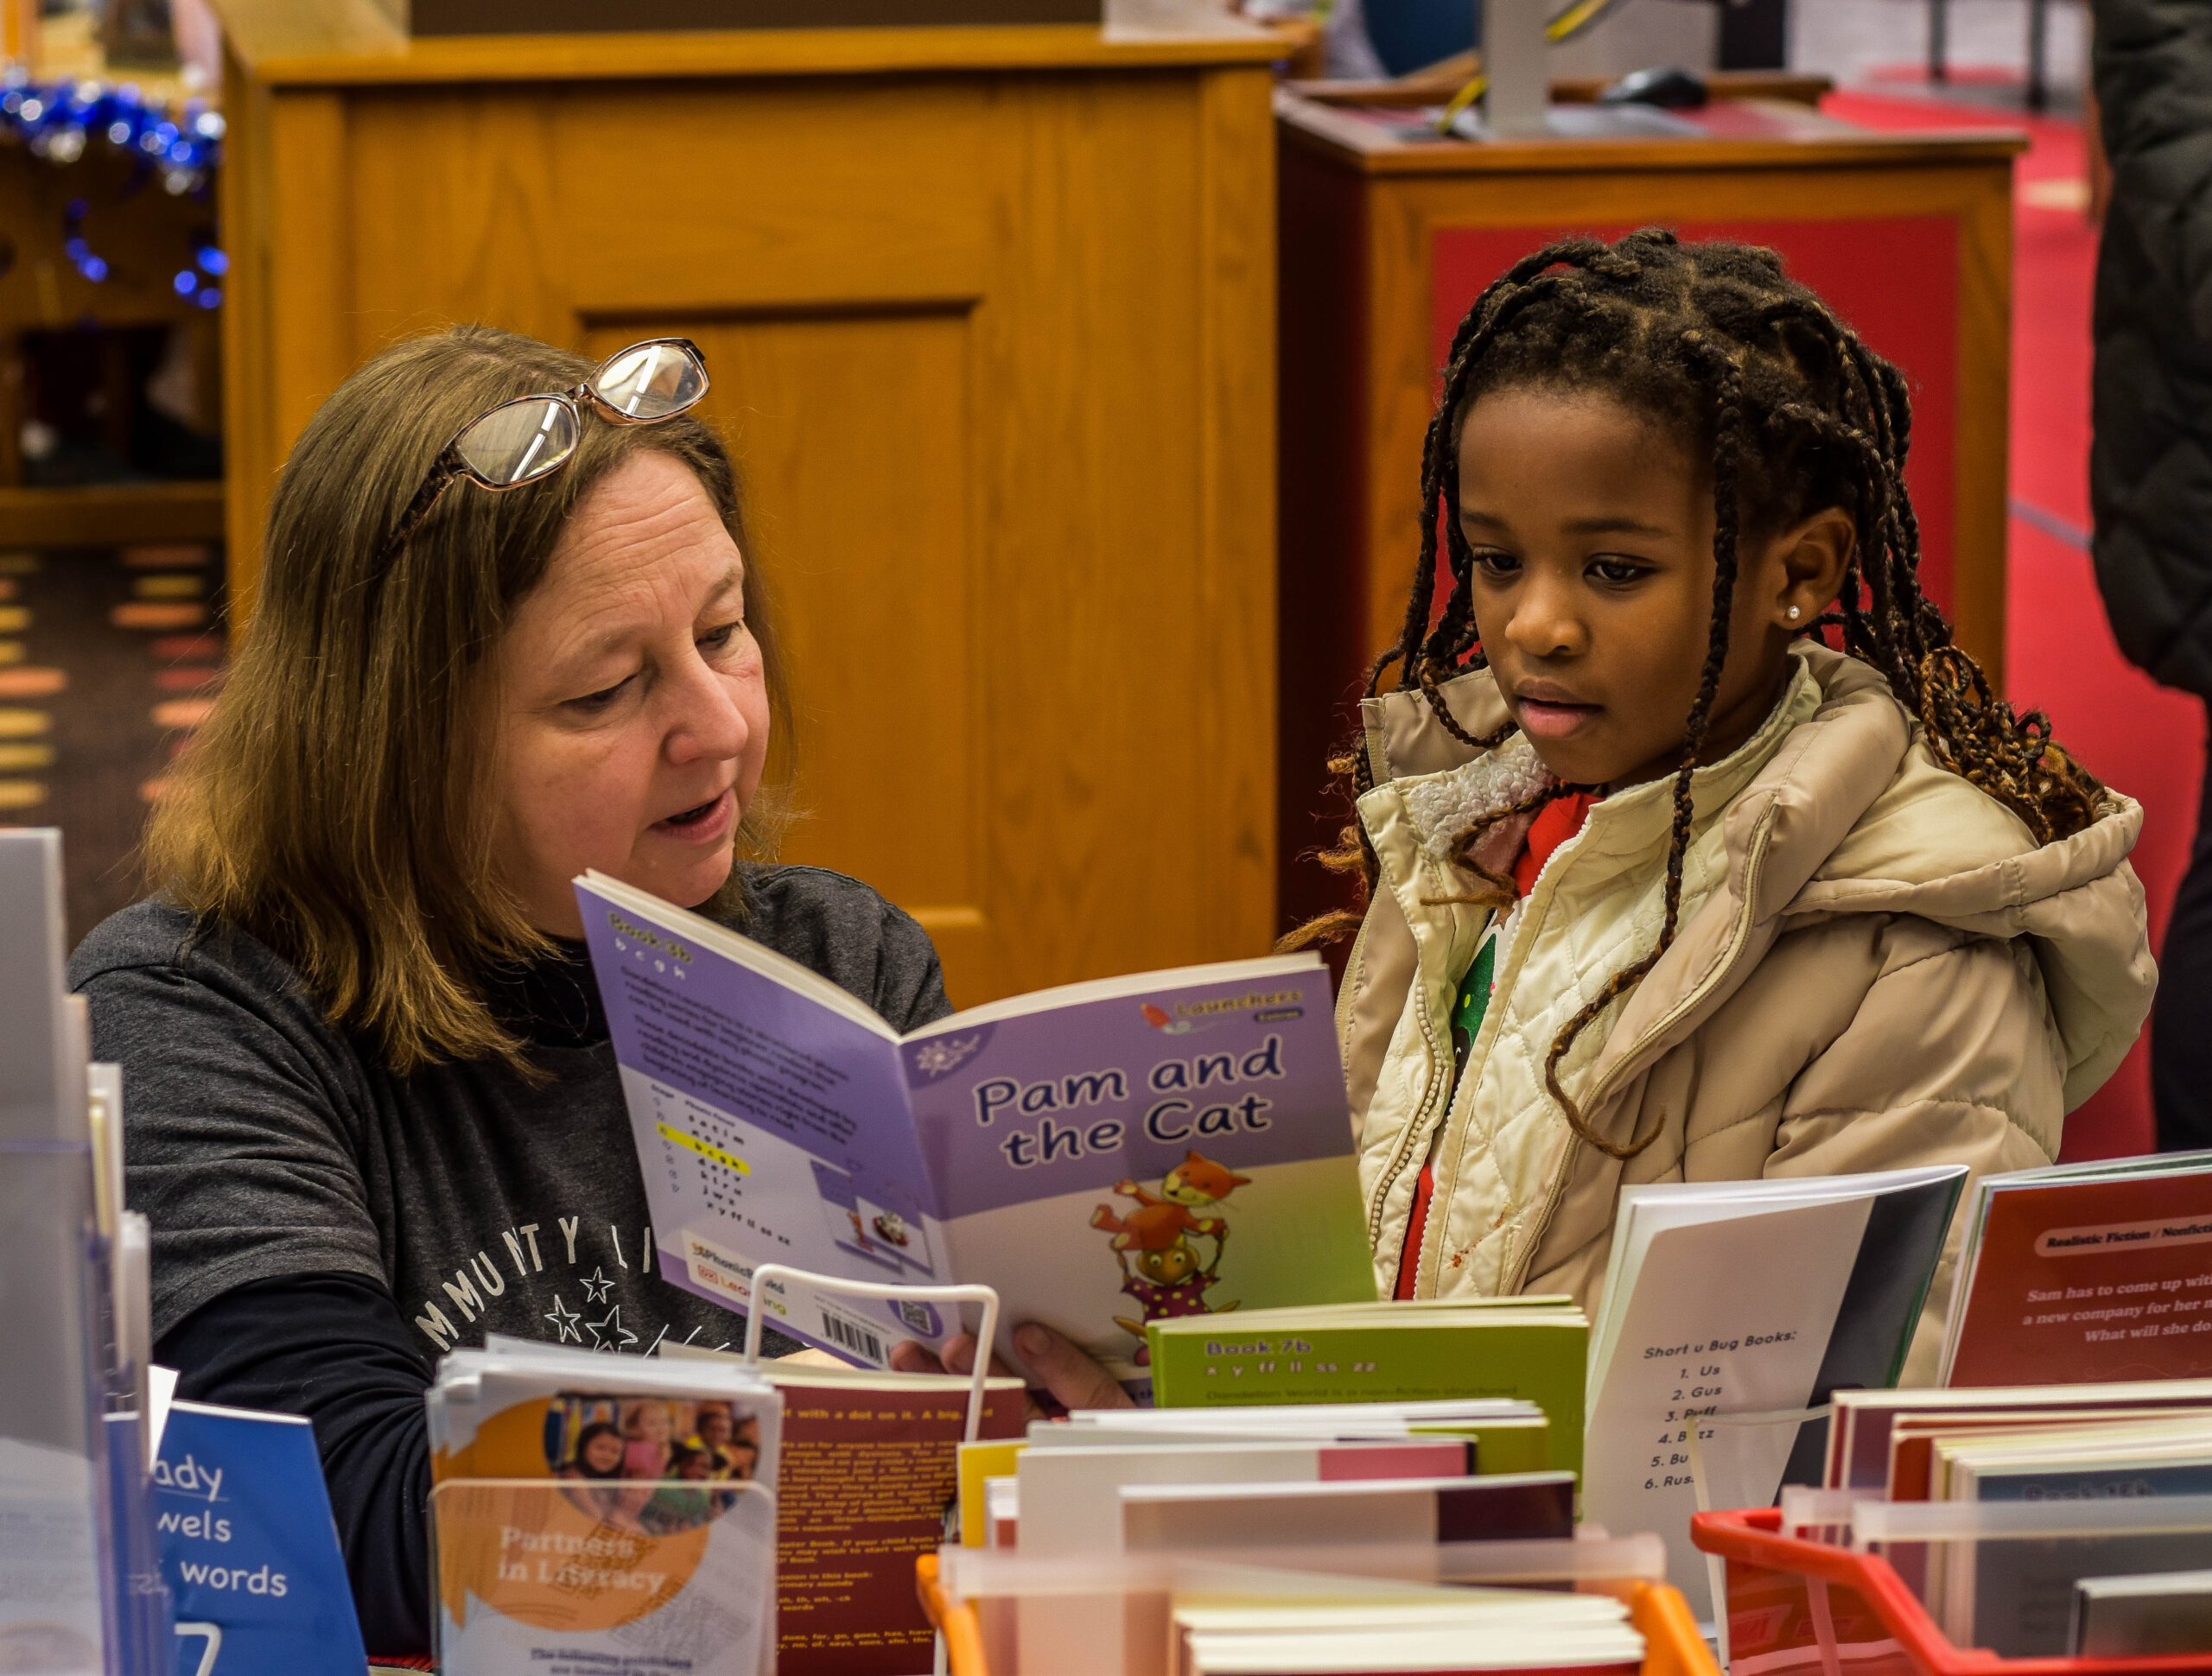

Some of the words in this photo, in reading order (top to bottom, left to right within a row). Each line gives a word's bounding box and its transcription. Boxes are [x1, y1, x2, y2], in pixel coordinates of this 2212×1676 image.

[976, 1070, 1125, 1124] Pam
[1153, 1038, 1281, 1089] and
[1005, 1120, 1123, 1165] the
[1147, 1095, 1270, 1141] Cat
[2047, 1235, 2103, 1247] Realistic
[2106, 1231, 2152, 1243] Fiction
[2027, 1290, 2063, 1302] Sam
[2066, 1287, 2094, 1298] has
[2097, 1286, 2113, 1296] to
[2116, 1281, 2158, 1294] come
[2162, 1279, 2183, 1292] up
[2023, 1316, 2034, 1325] a
[2036, 1312, 2071, 1324] new
[2072, 1305, 2144, 1321] company
[2145, 1302, 2172, 1315] for
[2173, 1298, 2202, 1311] her
[2085, 1329, 2126, 1342] What
[2130, 1324, 2159, 1338] will
[2162, 1323, 2189, 1336] she
[1206, 1341, 1271, 1356] Book
[1281, 1339, 1312, 1355] 7b
[1643, 1343, 1689, 1359] Short
[1694, 1344, 1704, 1354] u
[1708, 1340, 1739, 1351] Bug
[1745, 1331, 1797, 1348] Books:
[1680, 1368, 1689, 1380] 1.
[1700, 1366, 1721, 1377] Us
[1671, 1390, 1685, 1400] 2.
[1691, 1387, 1723, 1399] Gus
[1664, 1411, 1679, 1423] 3.
[1658, 1433, 1673, 1444] 4.
[1651, 1456, 1664, 1468] 5.
[1644, 1478, 1659, 1489] 6.
[180, 1560, 289, 1598] words
